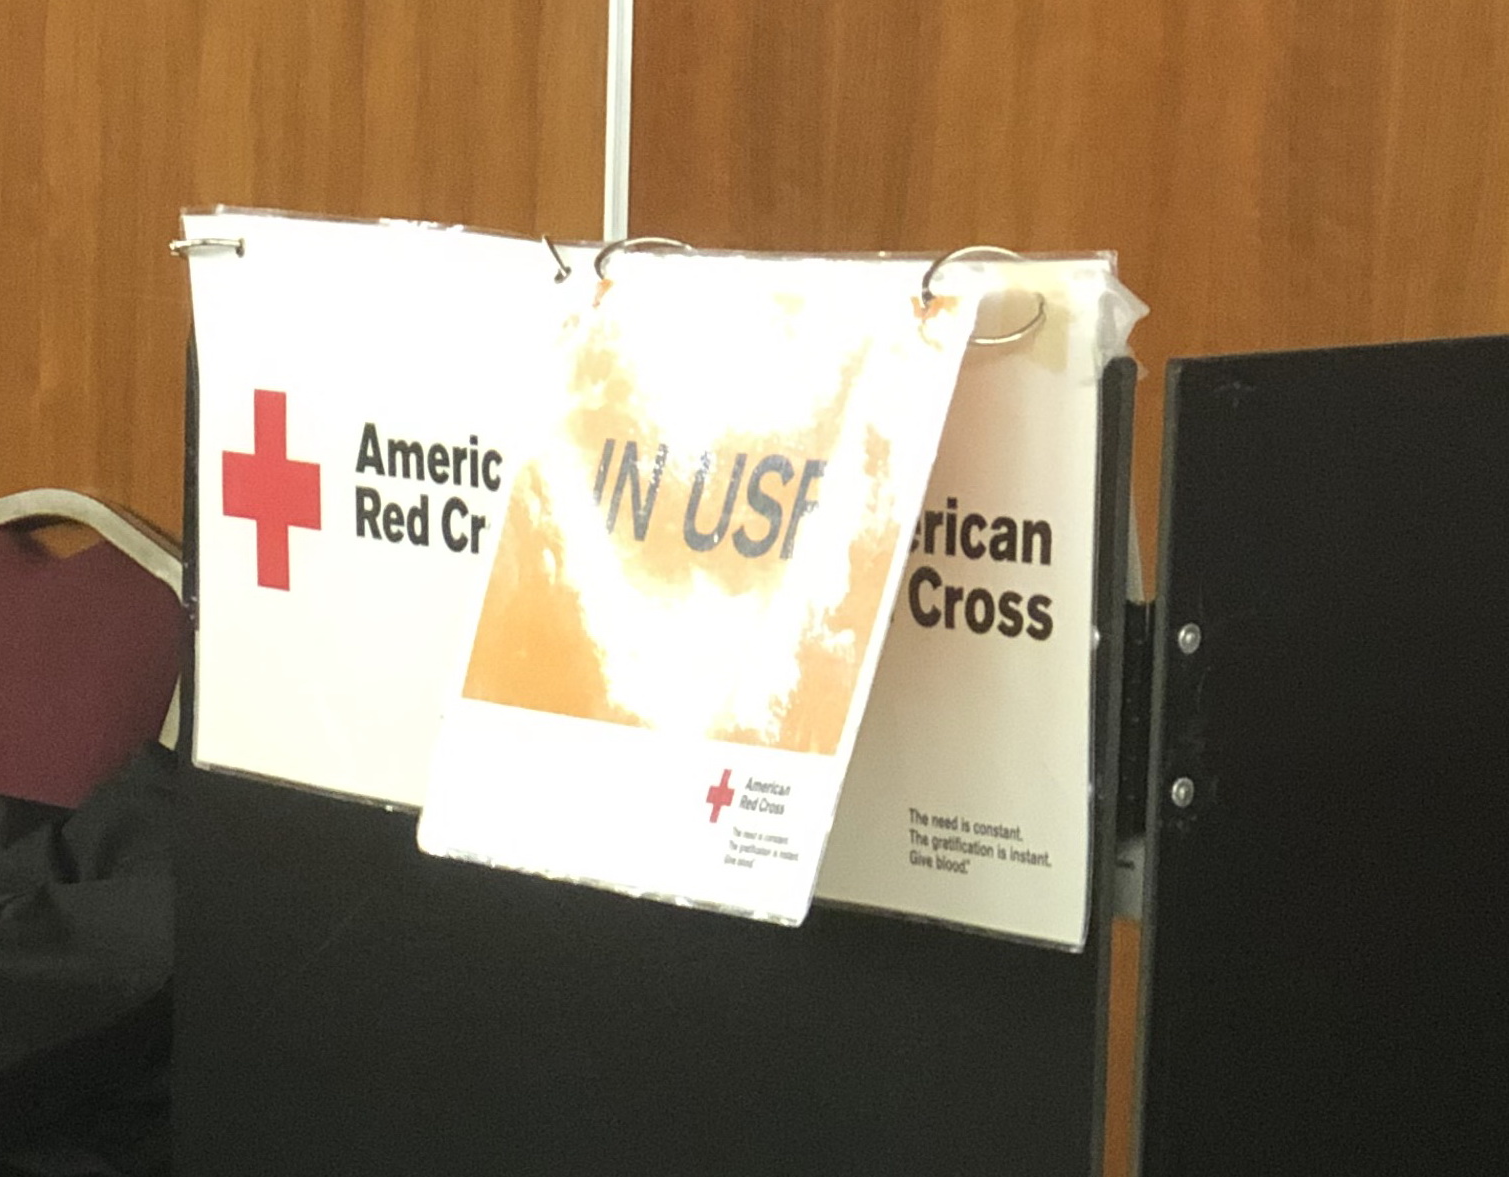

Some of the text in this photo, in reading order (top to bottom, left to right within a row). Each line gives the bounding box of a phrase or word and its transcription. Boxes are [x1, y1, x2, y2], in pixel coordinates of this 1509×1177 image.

[355, 422, 503, 492] Americ
[593, 438, 668, 542] IN
[355, 485, 490, 554] Red Cr
[908, 566, 1053, 641] Cross
[739, 795, 784, 814] Red Cross
[745, 777, 791, 796] American
[909, 808, 1023, 841] The need is constant.
[909, 829, 1052, 867] The gratification is instant.
[910, 850, 932, 869] Give
